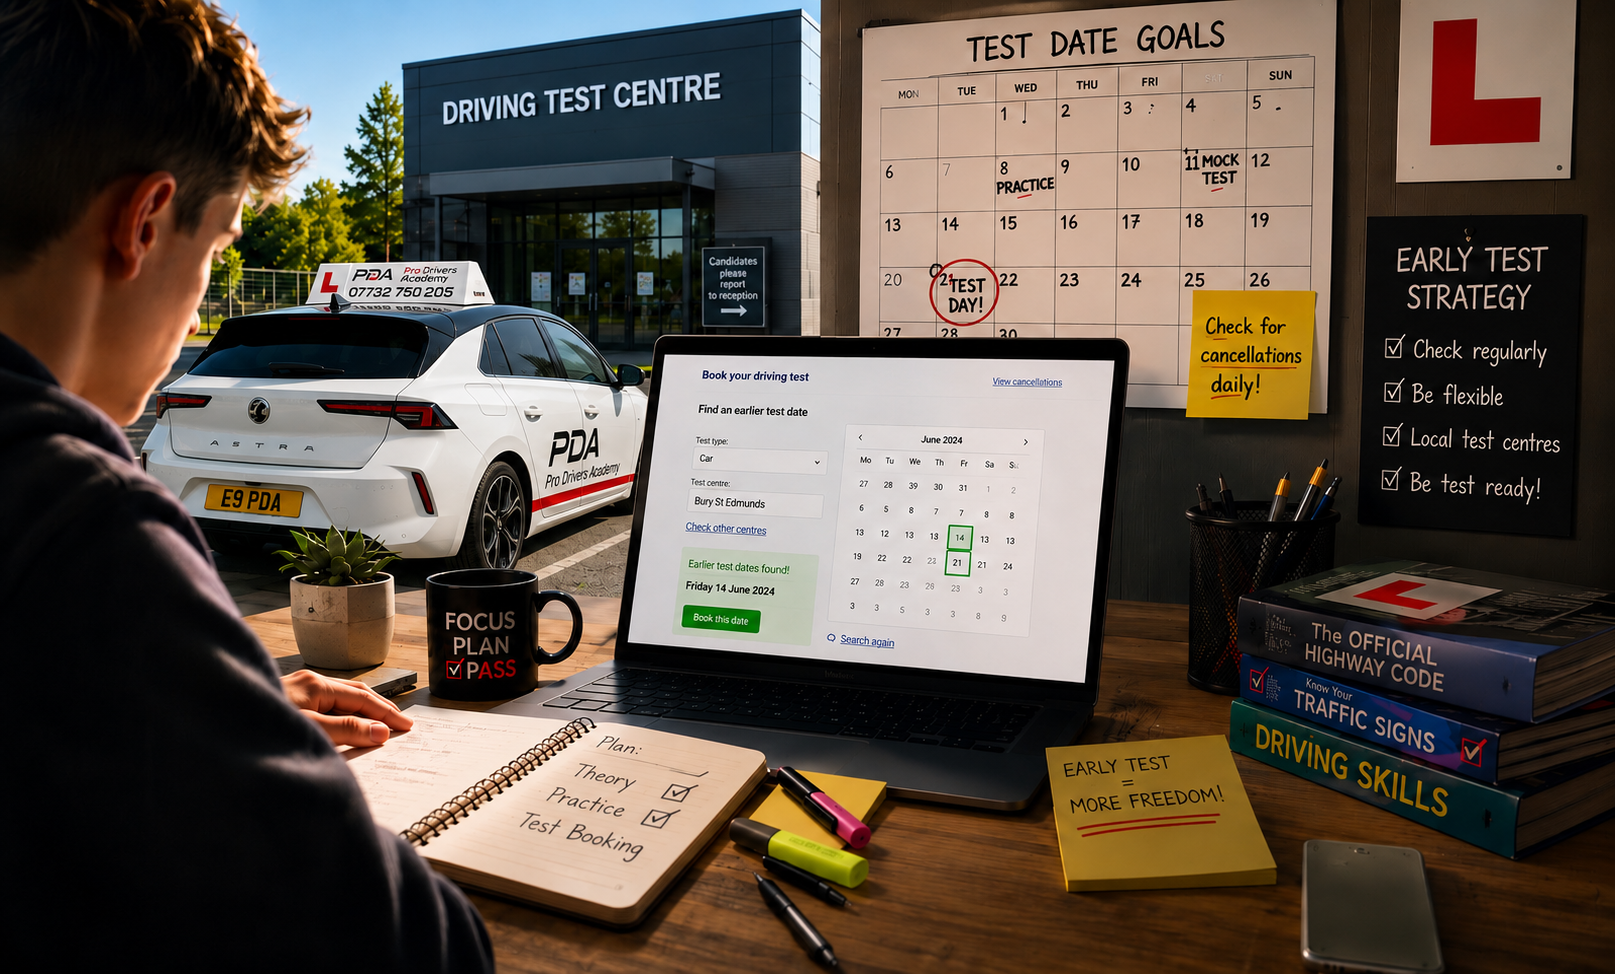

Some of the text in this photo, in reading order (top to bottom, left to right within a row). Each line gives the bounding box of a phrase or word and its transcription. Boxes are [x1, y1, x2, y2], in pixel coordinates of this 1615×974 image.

[966, 20, 1226, 62] TEST DATE GOALS
[898, 70, 1292, 99] MON TUE WED THU FRI SUN
[1430, 18, 1541, 146] L
[443, 72, 721, 125] DRIVING TEST CENTRE
[1000, 95, 1262, 121] 1 2 3 4 5
[885, 153, 1270, 179] 6 7 8 9 10 11 12
[1202, 153, 1240, 168] MOCK
[996, 177, 1055, 195] PRACTICE
[1202, 170, 1238, 185] TEST
[884, 212, 1270, 233] 13 14 15 16 17 18 19
[709, 256, 758, 266] Candidates
[1397, 246, 1549, 272] EARLY TEST
[320, 272, 338, 293] L
[352, 268, 392, 281] PDA
[400, 275, 448, 283] Academy
[720, 269, 747, 279] please
[884, 273, 902, 287] 20
[999, 273, 1018, 287] 22
[1060, 272, 1079, 288] 23
[1121, 273, 1142, 288] 24
[1184, 272, 1205, 288] 25
[1249, 272, 1270, 288] 26
[349, 287, 454, 297] 07732 750 205
[720, 280, 745, 290] report
[949, 278, 986, 293] TEST
[719, 291, 758, 301] reception
[949, 296, 983, 313] DAY!
[1407, 284, 1531, 311] STRATEGY
[1205, 316, 1286, 336] Check for
[1200, 346, 1302, 365] cancellations
[1413, 338, 1547, 368] Check regularly
[702, 370, 809, 383] Book your driving test
[993, 377, 1011, 386] View
[1210, 373, 1261, 401] daily!
[1412, 382, 1503, 406] Be flexible
[698, 404, 808, 417] Find an earlier test date
[210, 440, 314, 452] ASTRA
[548, 428, 599, 467] PDA
[696, 437, 728, 446] Test type:
[921, 435, 963, 444] June 2024
[1411, 427, 1561, 453] Local test centres
[699, 454, 713, 463] Car
[860, 456, 872, 464] Mo
[935, 458, 945, 466] Th
[960, 459, 968, 467] Fr
[985, 460, 995, 468] Sa
[545, 463, 620, 489] Pro Drivers Academy
[691, 478, 731, 488] Test centre:
[1410, 471, 1541, 505] Be test ready!
[221, 489, 281, 512] E9 PDA
[694, 496, 765, 509] Bury St Edmunds
[685, 522, 767, 536] Check other centres
[688, 559, 790, 575] Earlier test dates found!
[686, 581, 775, 596] Friday 14 June 2024
[445, 611, 515, 631] FOCUS
[693, 613, 749, 626] Book this date
[453, 636, 509, 655] PLAN
[840, 634, 895, 649] Search again
[1311, 622, 1342, 644] The
[1349, 630, 1437, 666] OFFICIAL
[467, 659, 517, 679] PASS
[1305, 643, 1445, 692] HIGHWAY CODE
[1306, 677, 1353, 701] Know Your
[1294, 689, 1435, 753] TRAFFIC SIGNS
[596, 735, 642, 755] Plan:
[1063, 755, 1170, 777] EARLY TEST
[1256, 723, 1449, 817] DRIVING SKILLS
[574, 762, 637, 794] Theory
[546, 786, 625, 817] Practice
[1070, 784, 1225, 814] MORE FREEDOM!
[519, 812, 644, 863] Test Booking
